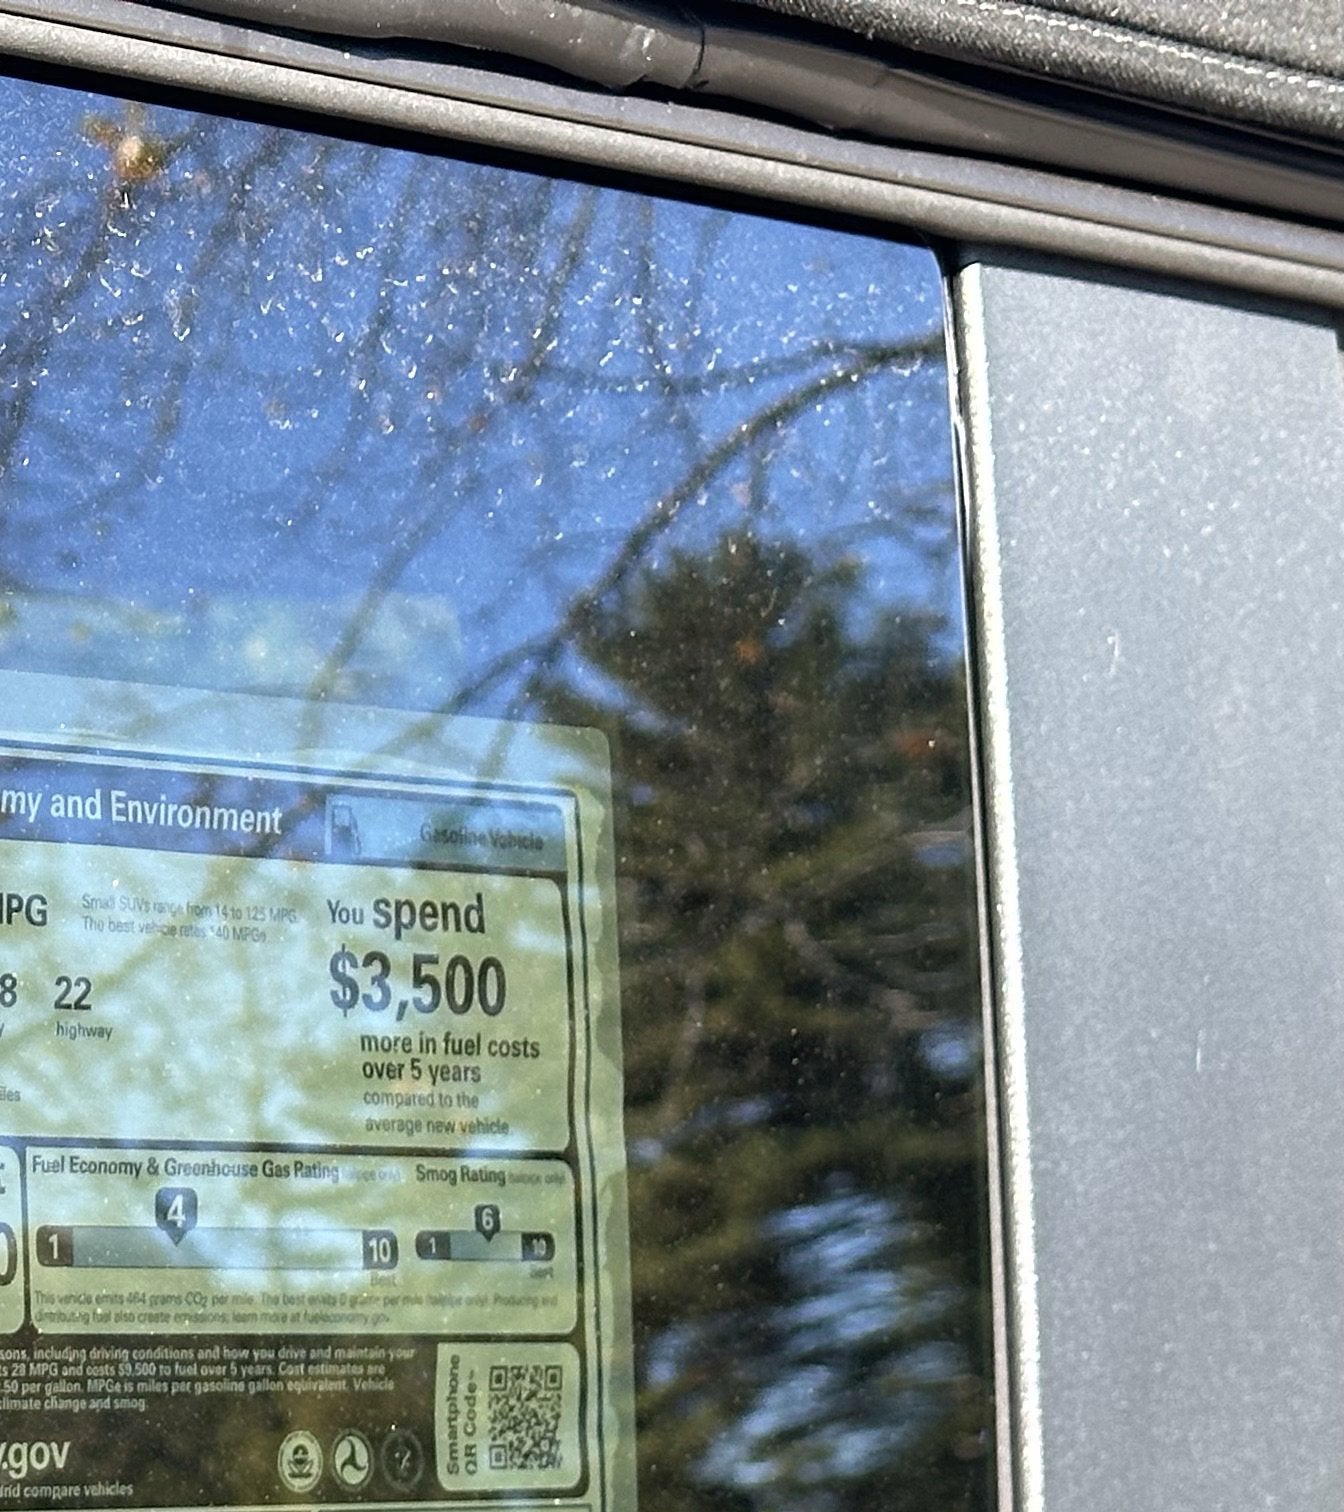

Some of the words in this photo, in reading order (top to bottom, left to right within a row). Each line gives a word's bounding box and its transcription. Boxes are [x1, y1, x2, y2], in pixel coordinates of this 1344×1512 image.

[51, 790, 101, 820] and
[112, 789, 283, 835] Environment
[327, 899, 365, 925] You
[373, 894, 486, 940] spend
[54, 976, 92, 1011] 22
[329, 943, 507, 1022] $3,500
[56, 1022, 113, 1040] highway
[361, 1033, 413, 1056] more
[419, 1031, 437, 1055] in
[442, 1033, 481, 1057] fuel
[488, 1037, 540, 1059] costs
[362, 1060, 403, 1080] over
[410, 1059, 422, 1080] 5
[428, 1063, 481, 1086] years
[416, 1165, 457, 1187] Smog
[460, 1166, 506, 1187] Rating
[167, 1194, 185, 1228] 4
[481, 1208, 493, 1230] 6
